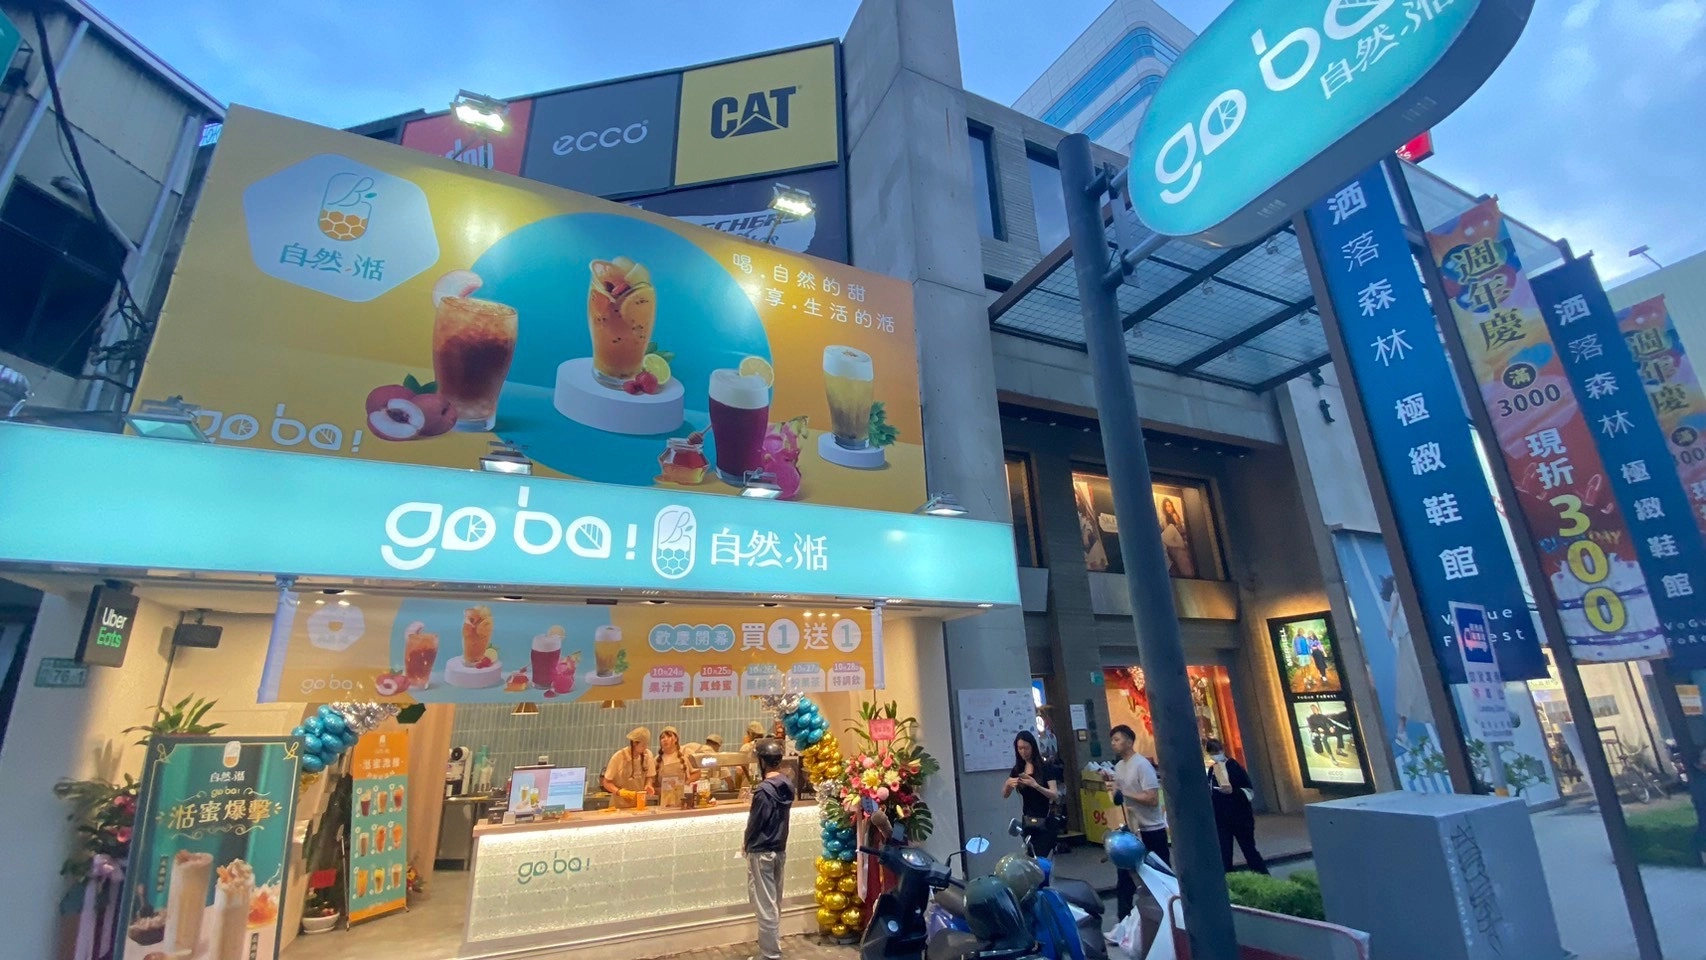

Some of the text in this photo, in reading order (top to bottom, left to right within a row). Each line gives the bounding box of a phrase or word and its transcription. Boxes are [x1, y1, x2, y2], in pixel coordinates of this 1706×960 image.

[711, 86, 796, 139] CAT
[552, 122, 647, 156] ecco
[1154, 89, 1247, 205] go
[1449, 238, 1527, 351] 週年慶
[1508, 367, 1531, 386] 滿
[1497, 384, 1561, 417] 3000
[1525, 427, 1575, 490] 現折
[380, 502, 496, 570] go
[1550, 494, 1627, 633] 300
[102, 607, 128, 629] Uber
[1441, 608, 1513, 626] Vue
[96, 627, 122, 648] Eats
[1443, 629, 1526, 647] Fest
[517, 860, 548, 885] go
